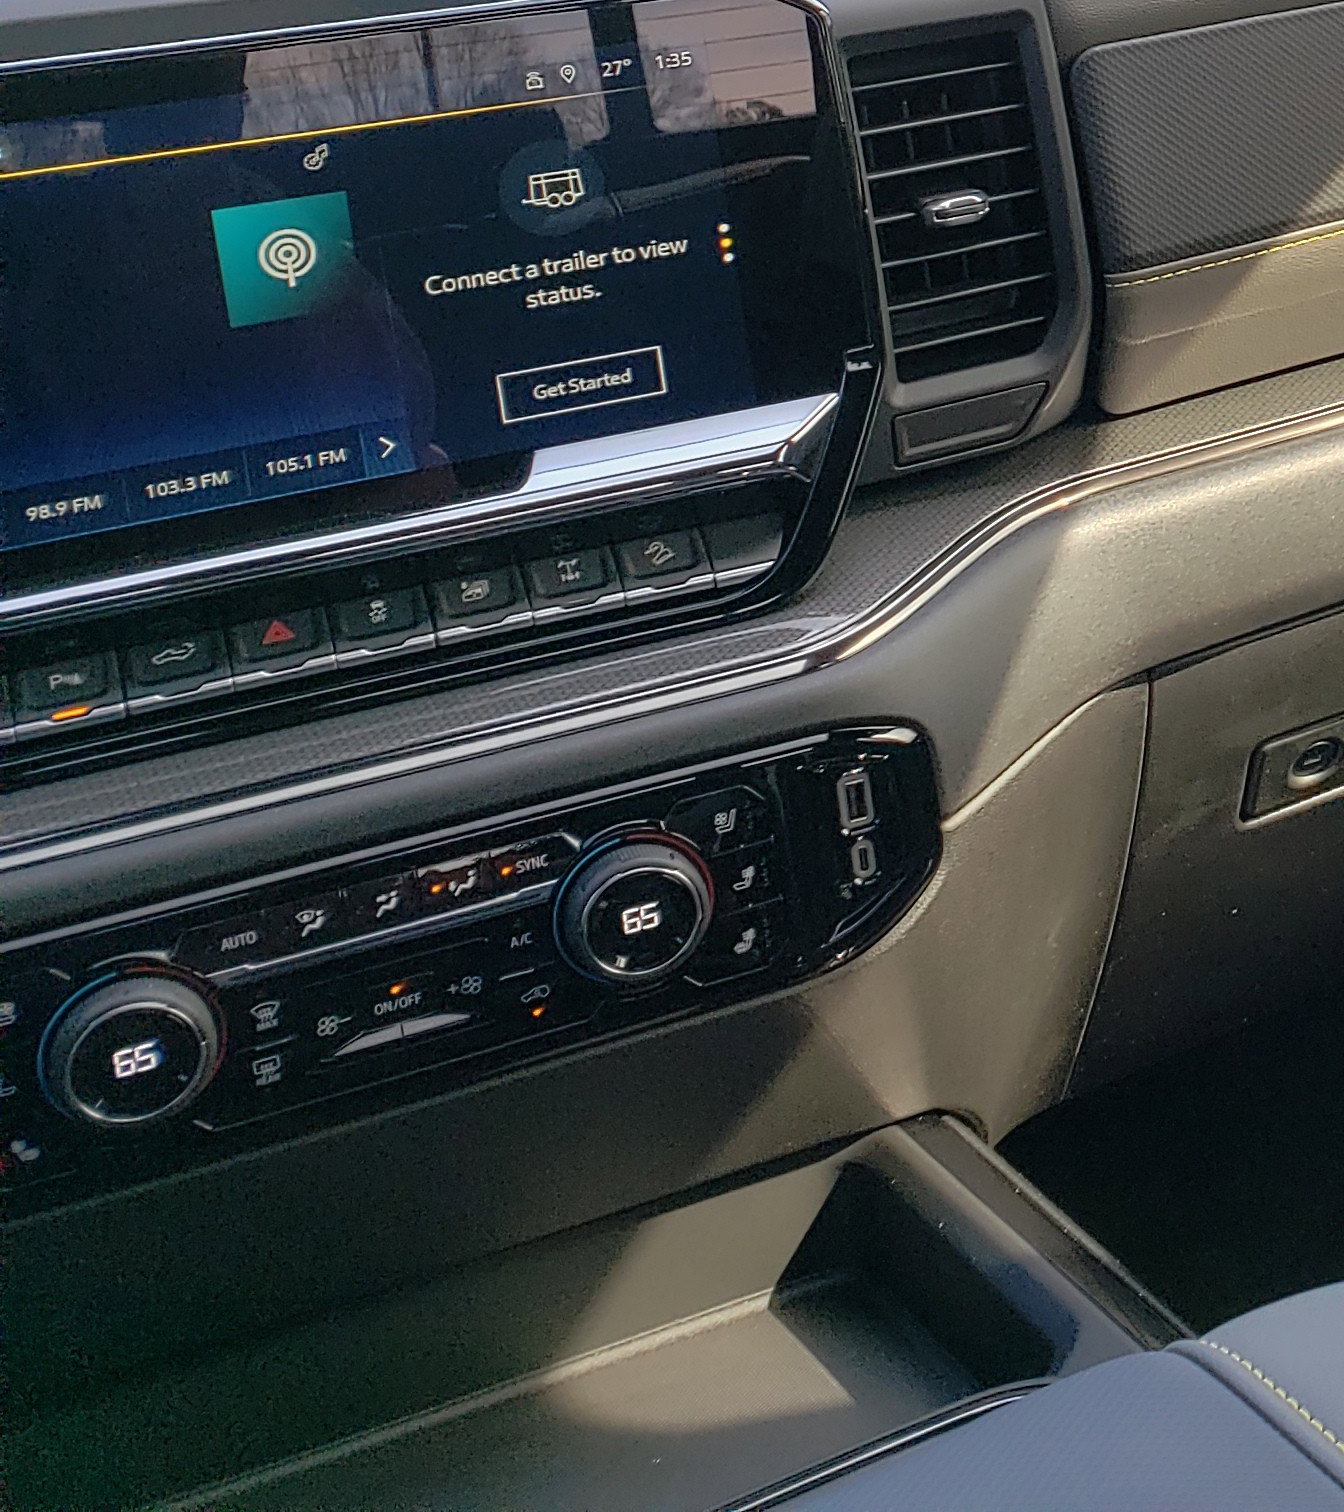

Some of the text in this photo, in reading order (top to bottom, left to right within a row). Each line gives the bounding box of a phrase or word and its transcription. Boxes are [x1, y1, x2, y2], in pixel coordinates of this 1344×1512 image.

[655, 51, 692, 69] 1:35
[424, 238, 689, 296] Connect a trailer to view
[525, 283, 603, 309] status.
[533, 367, 633, 400] Get Started
[265, 447, 348, 476] 105.1 FM
[145, 470, 231, 499] 103.3 FM
[25, 495, 103, 522] 98.9 FM
[515, 854, 549, 874] SYNC
[621, 900, 663, 935] 65
[220, 931, 258, 952] AUTO
[510, 932, 533, 948] A/C
[374, 991, 423, 1016] ON/OFF
[112, 1038, 160, 1079] 65
